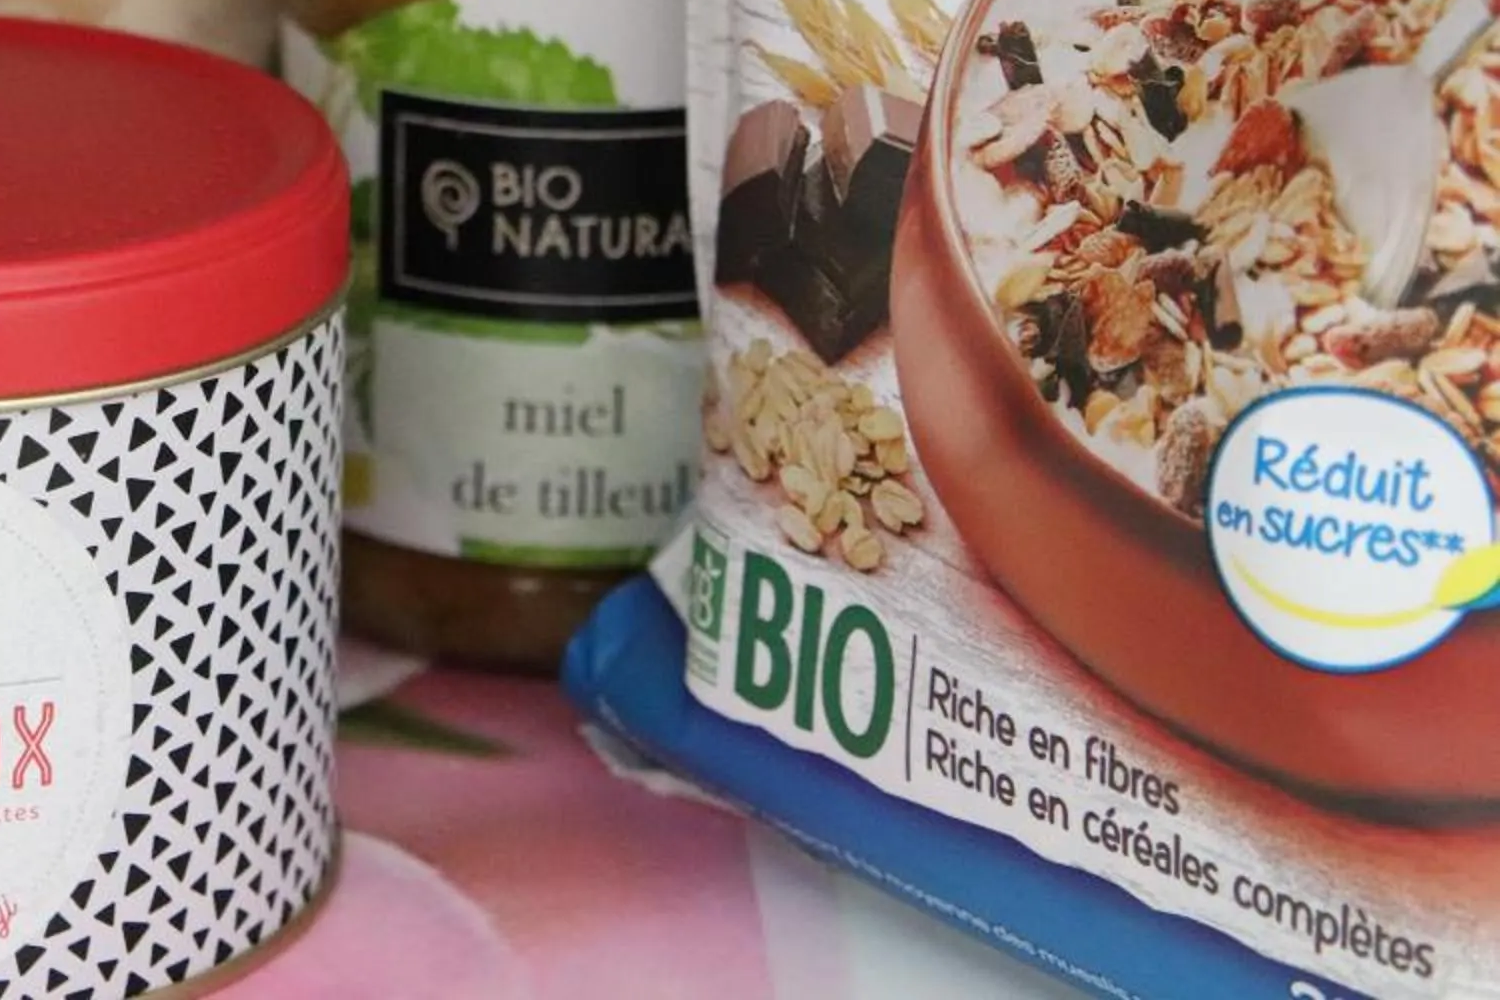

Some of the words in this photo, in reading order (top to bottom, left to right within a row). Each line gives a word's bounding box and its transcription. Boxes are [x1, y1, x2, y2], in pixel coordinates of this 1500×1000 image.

[491, 162, 583, 212] BIO
[500, 381, 627, 438] miel
[451, 462, 518, 515] de
[1253, 436, 1434, 511] Réduit
[1217, 501, 1252, 536] en
[734, 550, 895, 759] BIO
[927, 667, 1016, 746] Riche
[1029, 726, 1070, 769] en
[1085, 736, 1180, 815] fibres
[926, 728, 1016, 806] Riche
[1028, 787, 1069, 830] en
[1083, 807, 1219, 895] céréales
[1233, 875, 1435, 978] complètes
